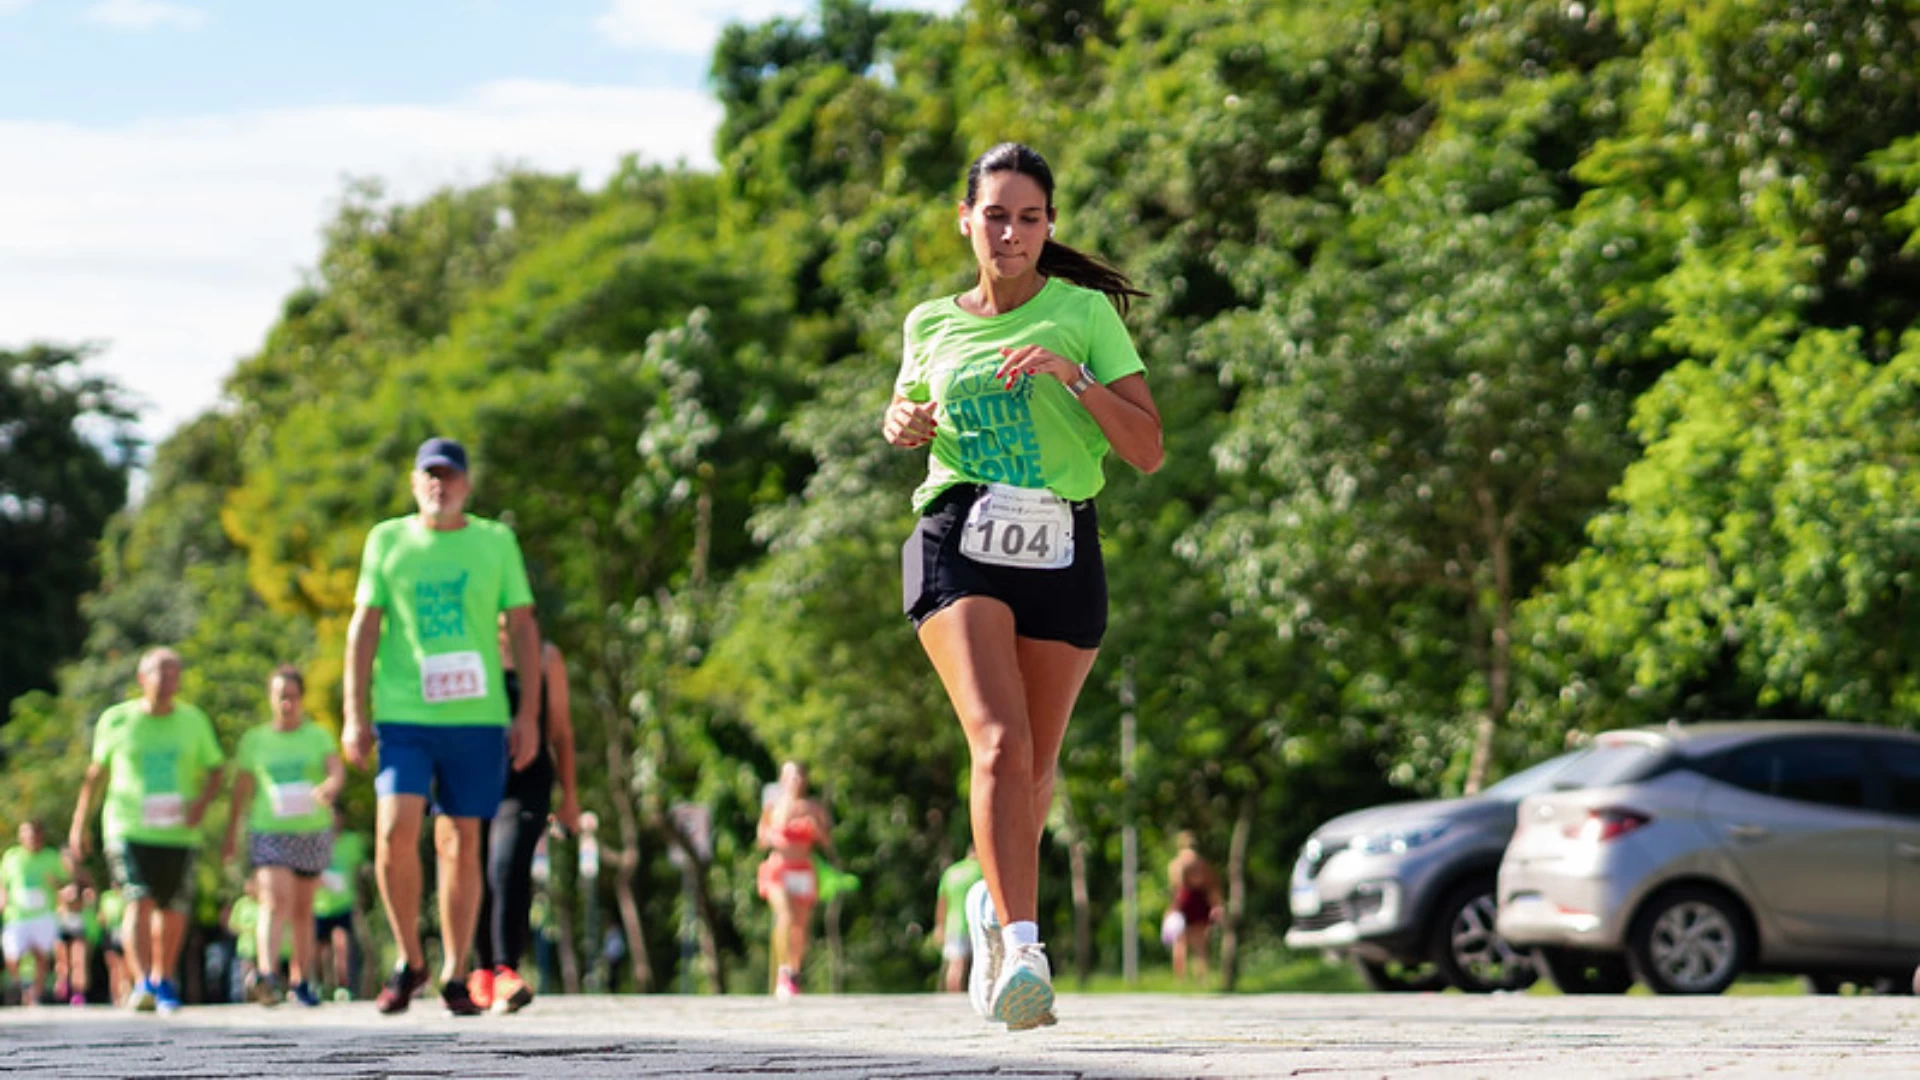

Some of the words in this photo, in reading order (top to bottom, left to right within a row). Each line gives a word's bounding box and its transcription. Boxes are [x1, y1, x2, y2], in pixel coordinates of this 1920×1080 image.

[944, 361, 1012, 401] 202
[946, 392, 1032, 432] FAITH
[958, 421, 1040, 461] HOPE
[962, 453, 1046, 488] LOVE
[977, 519, 1049, 557] 104
